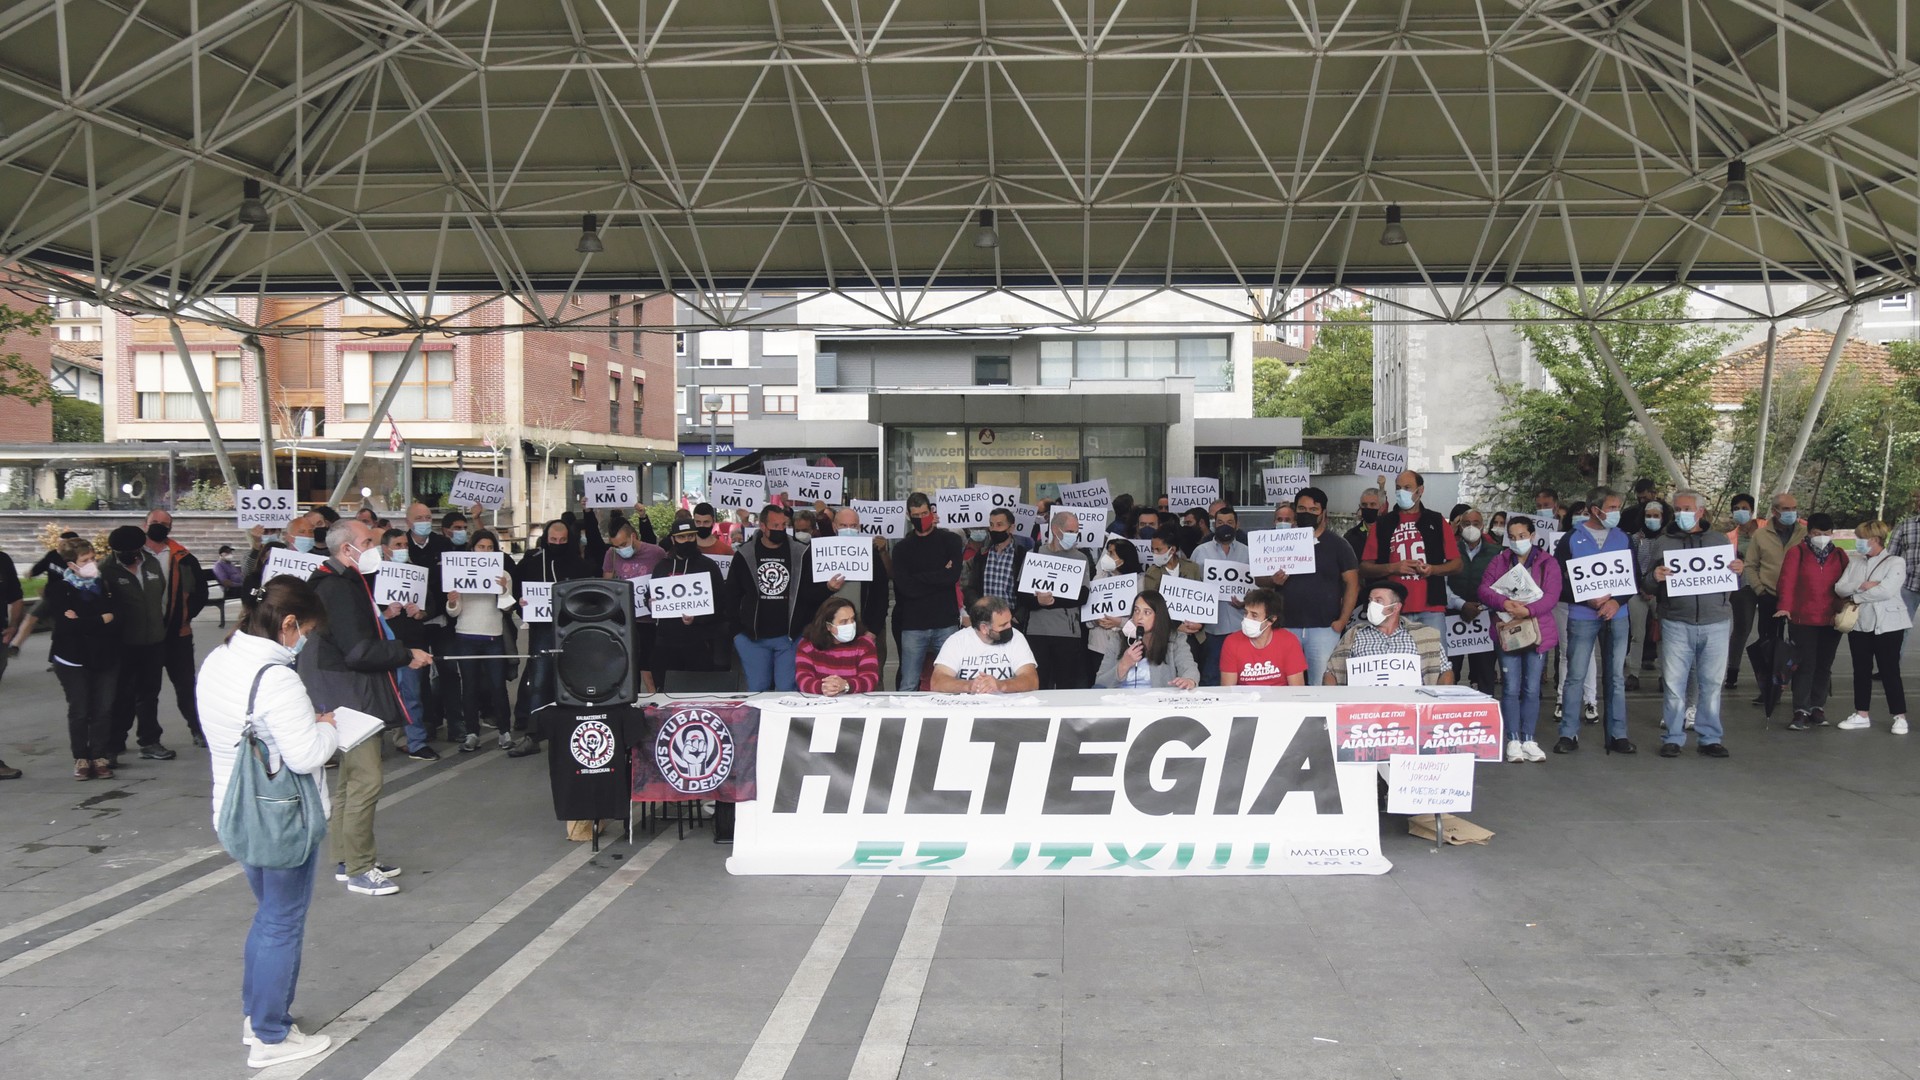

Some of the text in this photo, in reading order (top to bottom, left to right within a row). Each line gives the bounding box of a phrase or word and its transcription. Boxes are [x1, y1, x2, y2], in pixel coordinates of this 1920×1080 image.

[1361, 448, 1404, 463] HILTEGIA
[767, 467, 790, 477] HILTE
[1359, 460, 1403, 474] ZABALDU
[586, 475, 634, 484] MATADERO
[791, 470, 841, 481] MATADERO
[894, 475, 959, 489] OFERTA
[1266, 475, 1308, 485] HILTEGIA
[458, 478, 504, 494] HILTEGIA
[713, 477, 763, 488] MATADERO
[769, 480, 789, 488] ZABA
[454, 489, 502, 504] ZABALDU
[799, 487, 832, 499] KM 0
[1062, 486, 1106, 500] HILTEGIA
[1171, 485, 1217, 495] HILTEGIA
[1267, 487, 1302, 496] ZABALD
[241, 496, 292, 511] S.O.S.
[595, 492, 628, 503] KM 0
[721, 495, 753, 508] KM 0
[939, 492, 990, 503] MATADERO
[992, 493, 1017, 508] O.S.
[1171, 497, 1217, 507] ZABALDU
[853, 505, 904, 515] MATADERO
[241, 513, 292, 522] BASERRIAK
[948, 511, 983, 524] KM 0
[860, 524, 894, 535] KM 0
[1256, 532, 1308, 543] 11 LANPOSTU
[815, 546, 869, 558] HILTEGIA
[273, 556, 318, 573] HILTEG
[446, 556, 500, 568] HILTEGIA
[816, 561, 869, 573] ZABALDU
[1026, 559, 1082, 574] MATADERO
[380, 566, 426, 583] HILTEGIA
[1207, 567, 1254, 584] S.O.S
[1572, 559, 1630, 581] S.O.S.
[453, 578, 491, 589] KM 0
[1031, 578, 1069, 593] KM 0
[1575, 577, 1632, 594] BASERRIAK
[1670, 573, 1733, 588] BASERRIAK
[386, 589, 419, 603] KM 0
[526, 586, 551, 596] HILT
[654, 581, 709, 601] S.O.S.
[1163, 585, 1215, 603] HILTEGIA
[1220, 585, 1252, 595] SERRIA
[655, 599, 710, 612] BASERRIAK
[1091, 599, 1126, 614] KM 0
[1167, 601, 1215, 617] ABALDU
[1447, 619, 1488, 637] .O.S.
[1352, 658, 1417, 675] HILTEGIA
[959, 668, 979, 680] EZ
[575, 723, 611, 738] TUBACEX
[660, 710, 728, 742] TUBACEX
[1341, 736, 1415, 749] AIARALDEA
[1423, 735, 1496, 749] AIARALDEA
[572, 738, 613, 767] SALBA DEZAGUN
[657, 743, 732, 791] SALBA DEZAGUN
[771, 715, 1344, 816] HILTEGIA
[1400, 761, 1450, 771] 11 LANPOSTU
[1409, 774, 1441, 782] JOKOAN
[1410, 786, 1438, 795] PUESTOS
[1448, 788, 1471, 797] TRABAJO
[1427, 798, 1455, 806] PELIGRO
[836, 841, 1271, 870] EZ ITXI!!
[1290, 848, 1369, 857] MATADERO
